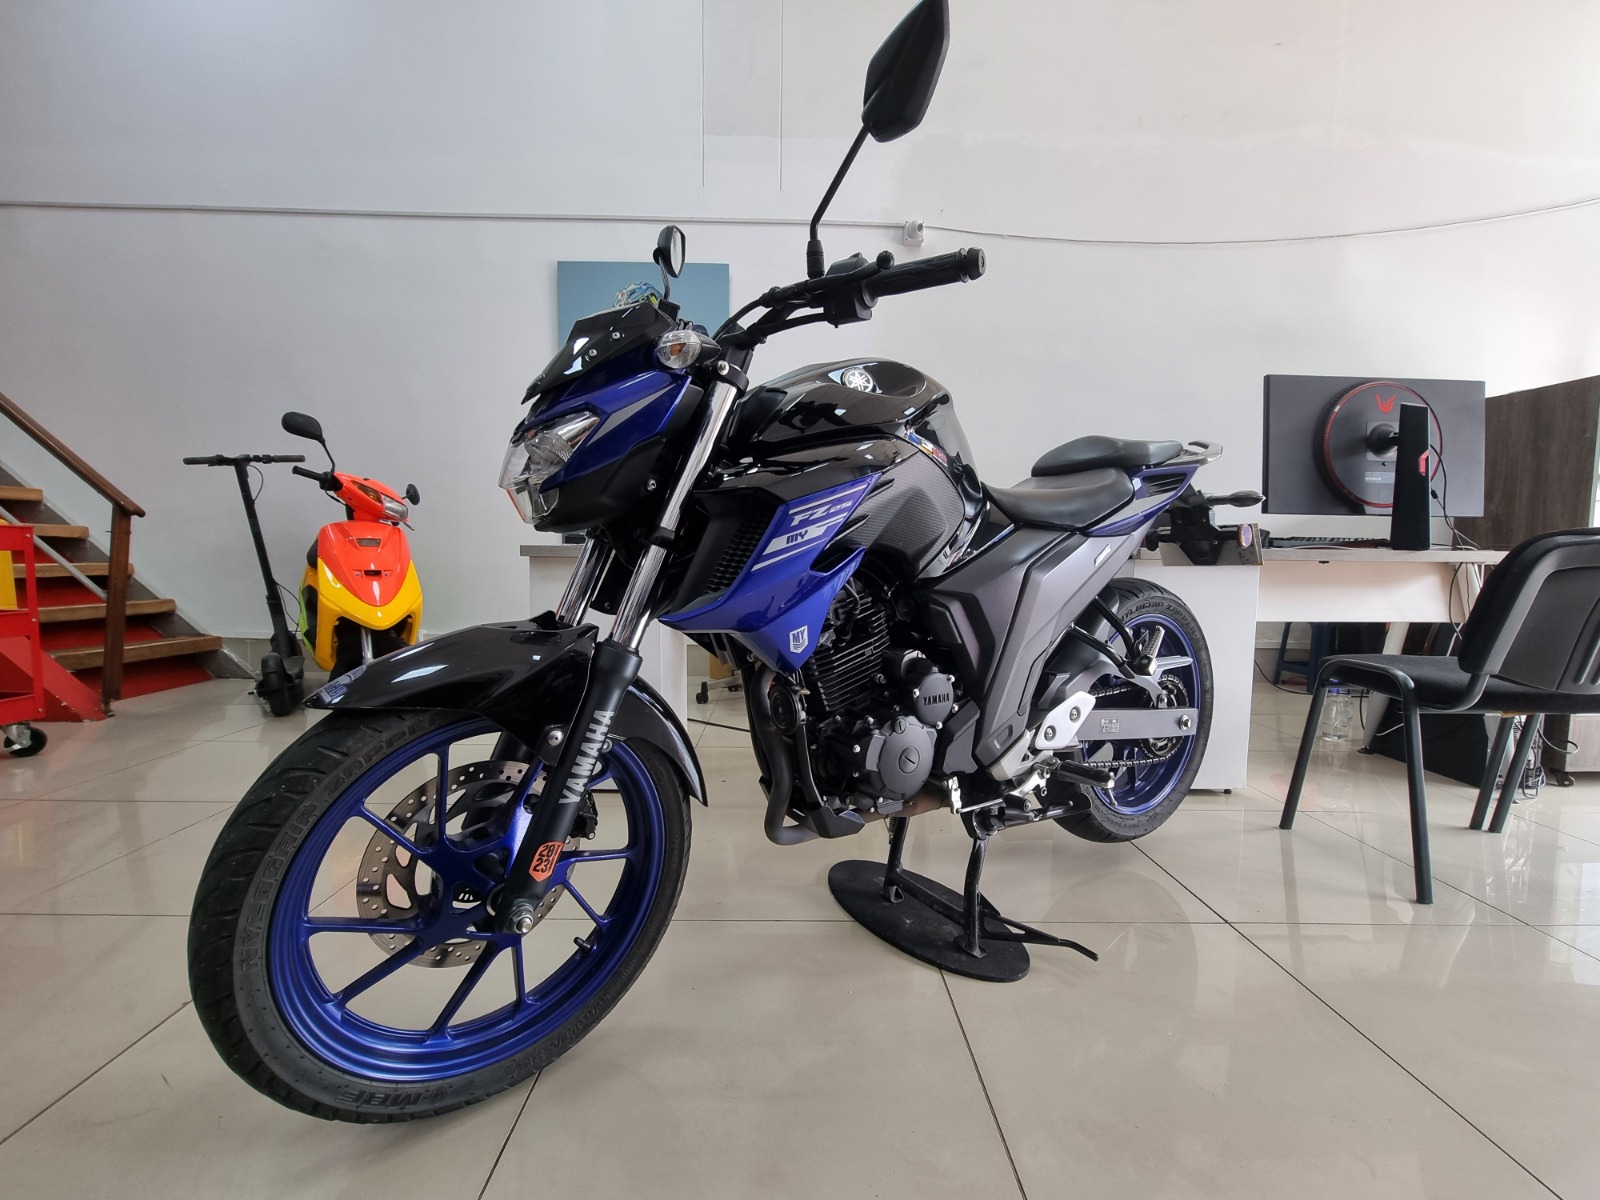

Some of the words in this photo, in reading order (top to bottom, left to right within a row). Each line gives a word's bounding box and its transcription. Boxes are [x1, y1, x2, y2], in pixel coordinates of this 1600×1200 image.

[786, 530, 808, 545] MY
[791, 628, 807, 643] MY
[923, 692, 950, 706] YAMAHA
[558, 709, 616, 804] YAMAHA
[532, 857, 551, 873] 23
